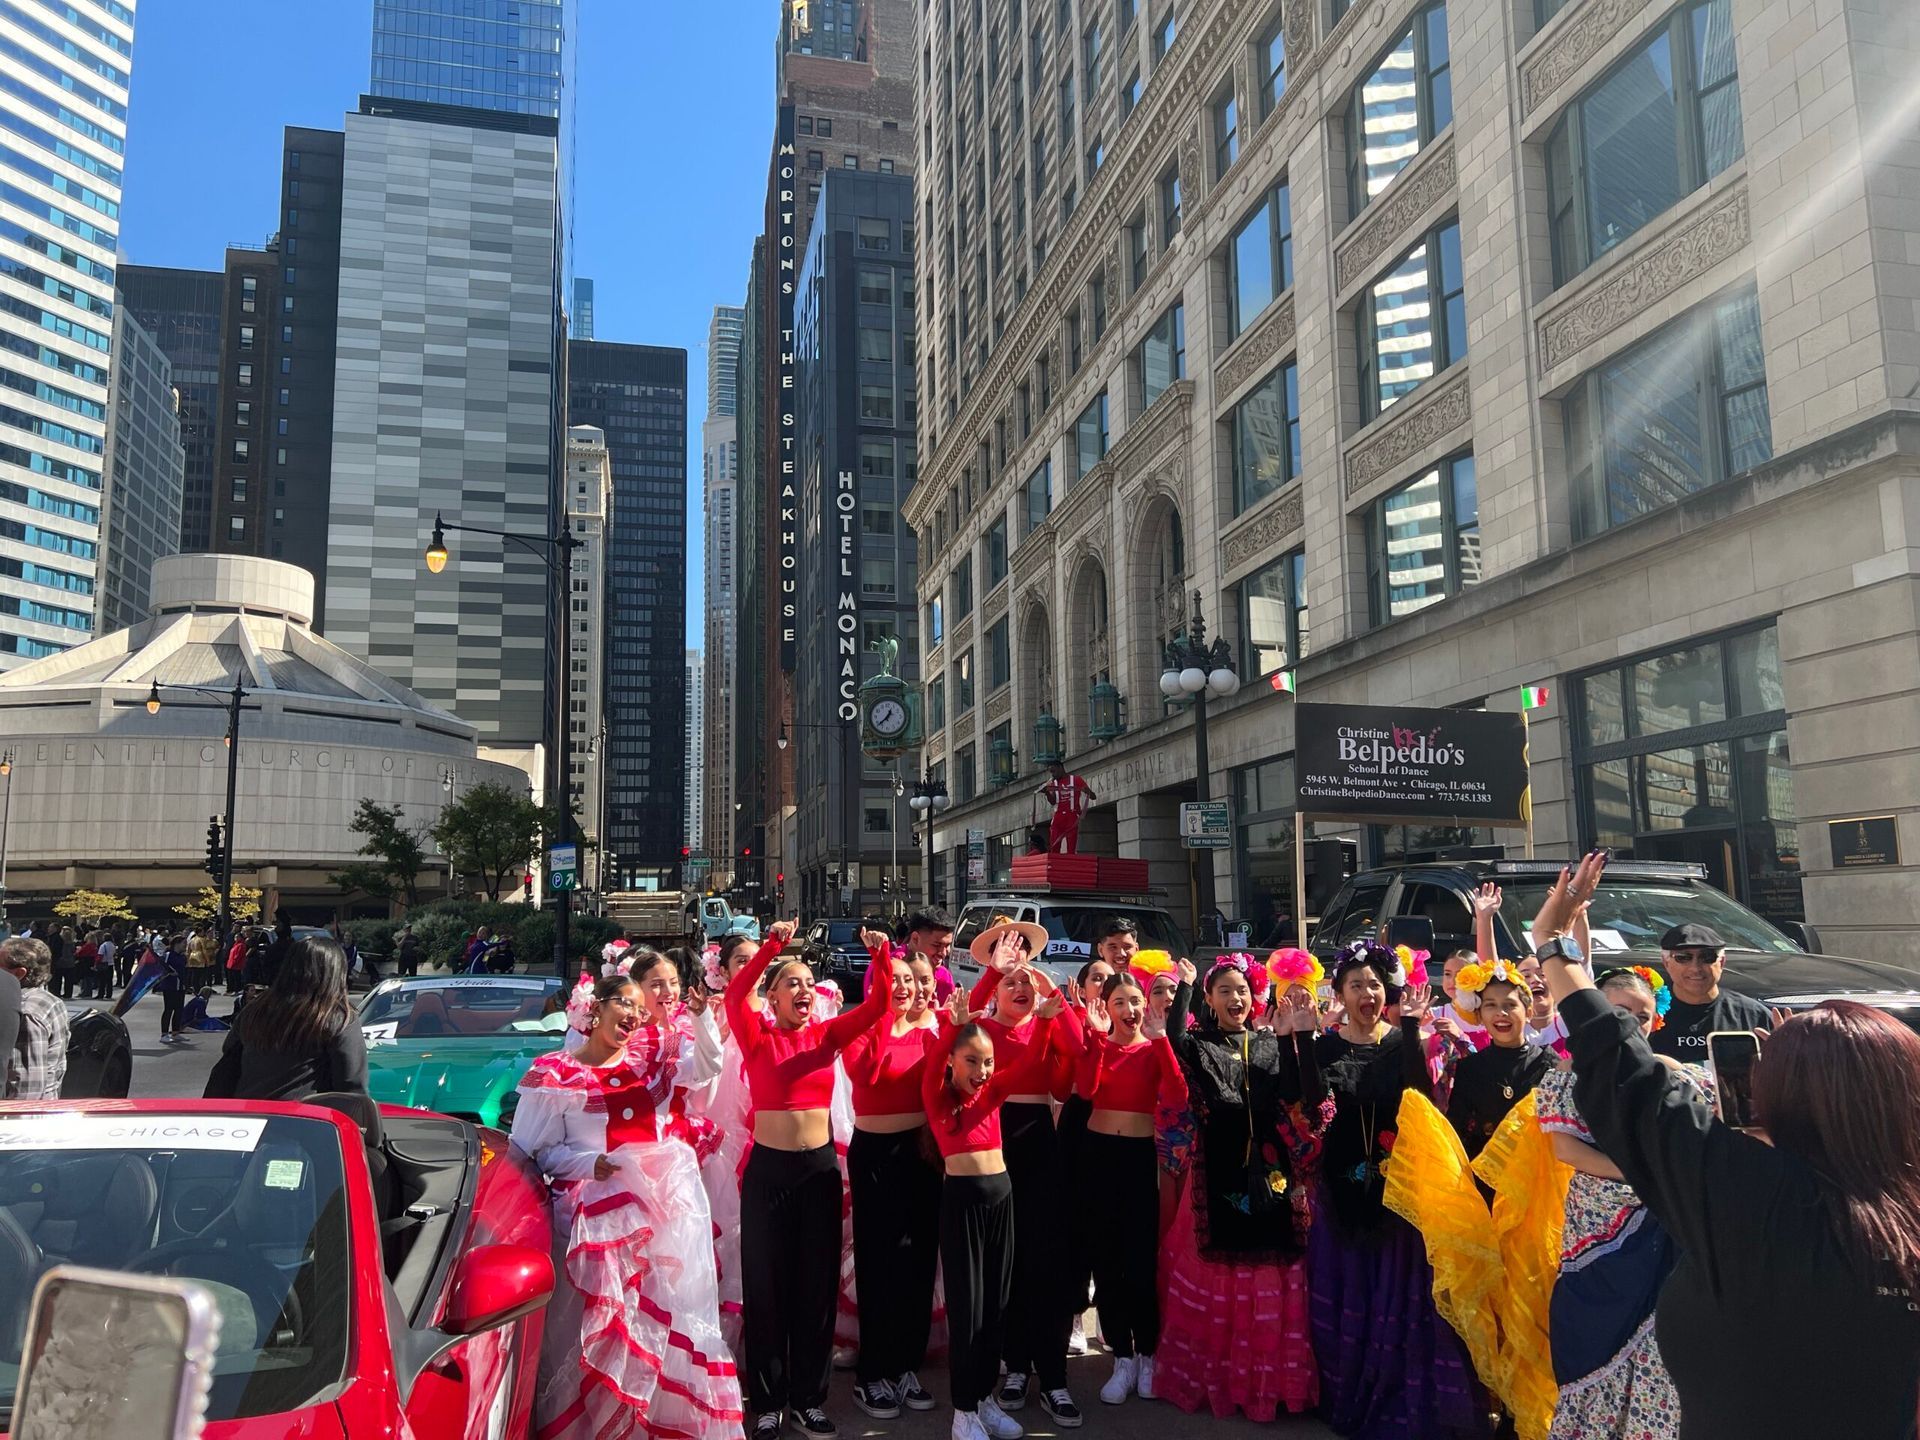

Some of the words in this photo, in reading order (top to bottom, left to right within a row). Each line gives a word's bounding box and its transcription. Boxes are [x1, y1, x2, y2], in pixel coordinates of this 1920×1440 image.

[779, 143, 795, 294] MORTONS
[782, 329, 794, 389] THE
[781, 413, 795, 642] STEAKHOUSE
[836, 471, 856, 576] HOTEL
[837, 591, 858, 721] MONACO
[1336, 726, 1390, 740] Christine
[381, 756, 417, 774] OF
[1337, 735, 1465, 775] Belpedio's
[1088, 768, 1119, 793] CKER
[1125, 752, 1164, 784] DRIVE
[1305, 775, 1327, 784] 5945
[1329, 776, 1341, 785] W.
[1343, 776, 1380, 787] Belmont
[1382, 778, 1398, 787] Ave
[1410, 779, 1448, 791] Chicago,
[1450, 781, 1461, 790] IL
[1461, 781, 1486, 791] 60634
[1348, 764, 1379, 774] School
[1389, 766, 1399, 775] of
[1401, 766, 1429, 776] Dance
[1300, 786, 1426, 801] ChristineBelpedioDance.com
[1438, 792, 1492, 803] 773.745.1383
[1050, 943, 1067, 952] 38
[1071, 945, 1083, 954] A
[107, 1127, 250, 1140] CHICAGO
